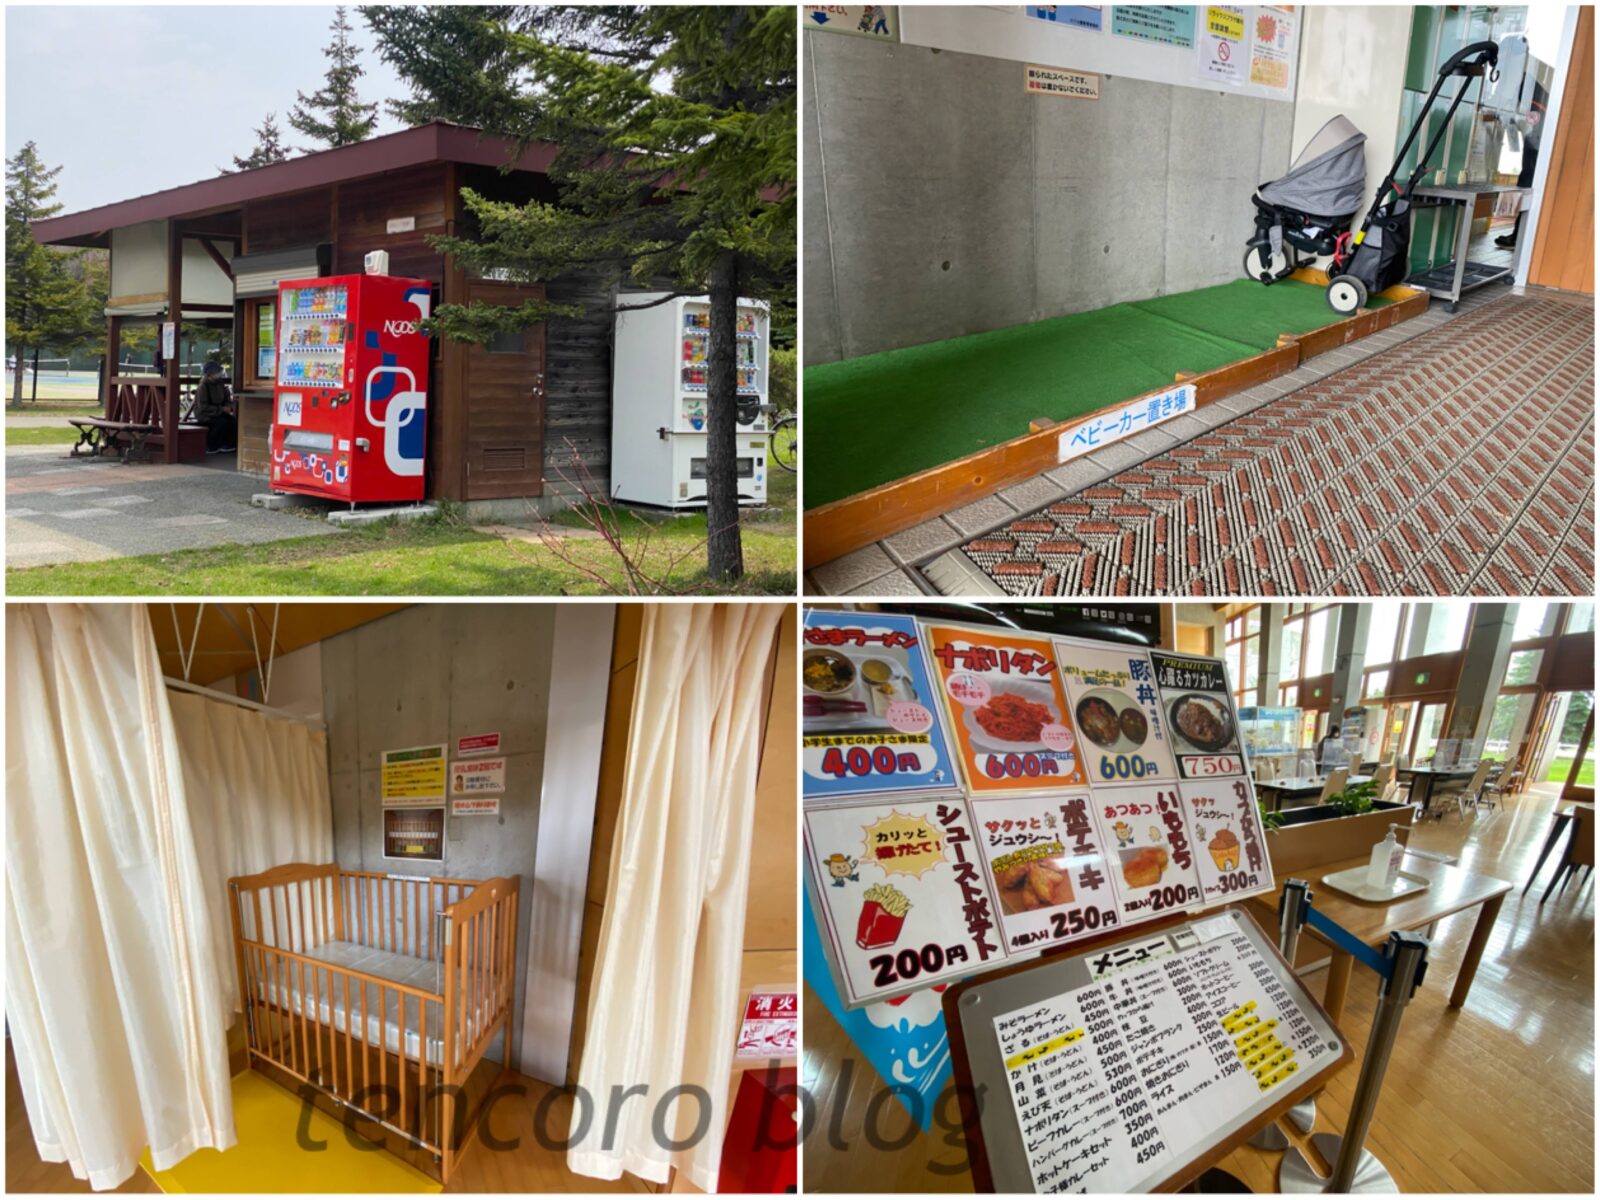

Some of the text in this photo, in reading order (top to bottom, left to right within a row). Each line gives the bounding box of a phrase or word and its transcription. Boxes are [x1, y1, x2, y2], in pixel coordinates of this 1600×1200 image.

[1071, 389, 1188, 446] ベビーカー置き場
[803, 627, 918, 650] さまラーメン
[934, 643, 1057, 676] ナポリタン
[1162, 658, 1214, 671] PREMIUM
[1158, 667, 1224, 689] 心躍るカツカレー
[822, 746, 921, 778] 400円
[985, 753, 1059, 778] 600円
[1100, 754, 1159, 779] 600円
[1184, 757, 1241, 775] 750円
[876, 828, 928, 843] カリッと
[984, 817, 1041, 833] サクッと
[1157, 791, 1192, 871] いももち
[936, 804, 998, 961] シューストポテト
[1218, 870, 1259, 894] 300円
[1150, 884, 1199, 911] 200円
[1011, 905, 1118, 947] 4個入り 250円
[869, 943, 969, 987] 200円
[1093, 941, 1165, 974] メニュー
[755, 996, 794, 1011] 消火
[998, 989, 1102, 1031] みそラーメン 600円
[1084, 1008, 1110, 1022] 450円
[1001, 999, 1105, 1042] しょうゆラーメン 600円
[1088, 1018, 1114, 1034] 500円
[1092, 1029, 1118, 1044] 400円
[1126, 1024, 1156, 1042] たこ焼き
[1131, 1023, 1182, 1054] ジャンボフランク
[1136, 1046, 1163, 1065] ポテチキ
[1196, 1020, 1218, 1034] 250円
[1203, 1030, 1224, 1044] 150円
[1097, 1040, 1122, 1056] 450円
[1101, 1051, 1127, 1069] 500円
[1105, 1062, 1132, 1081] 530円
[1145, 1060, 1190, 1089] 焼きおにぎり
[1209, 1039, 1230, 1055] 170円
[1151, 1084, 1175, 1101] ライス
[1214, 1050, 1236, 1066] 120円
[1221, 1061, 1242, 1078] 150円
[1110, 1074, 1137, 1094] 600円
[1115, 1086, 1142, 1107] 600円
[1119, 1099, 1148, 1120] 700円
[1037, 1112, 1153, 1185] ホットケーキセット 350円
[1043, 1126, 1159, 1194] 子様カレーセット 400円
[1137, 1140, 1165, 1164] 450円
